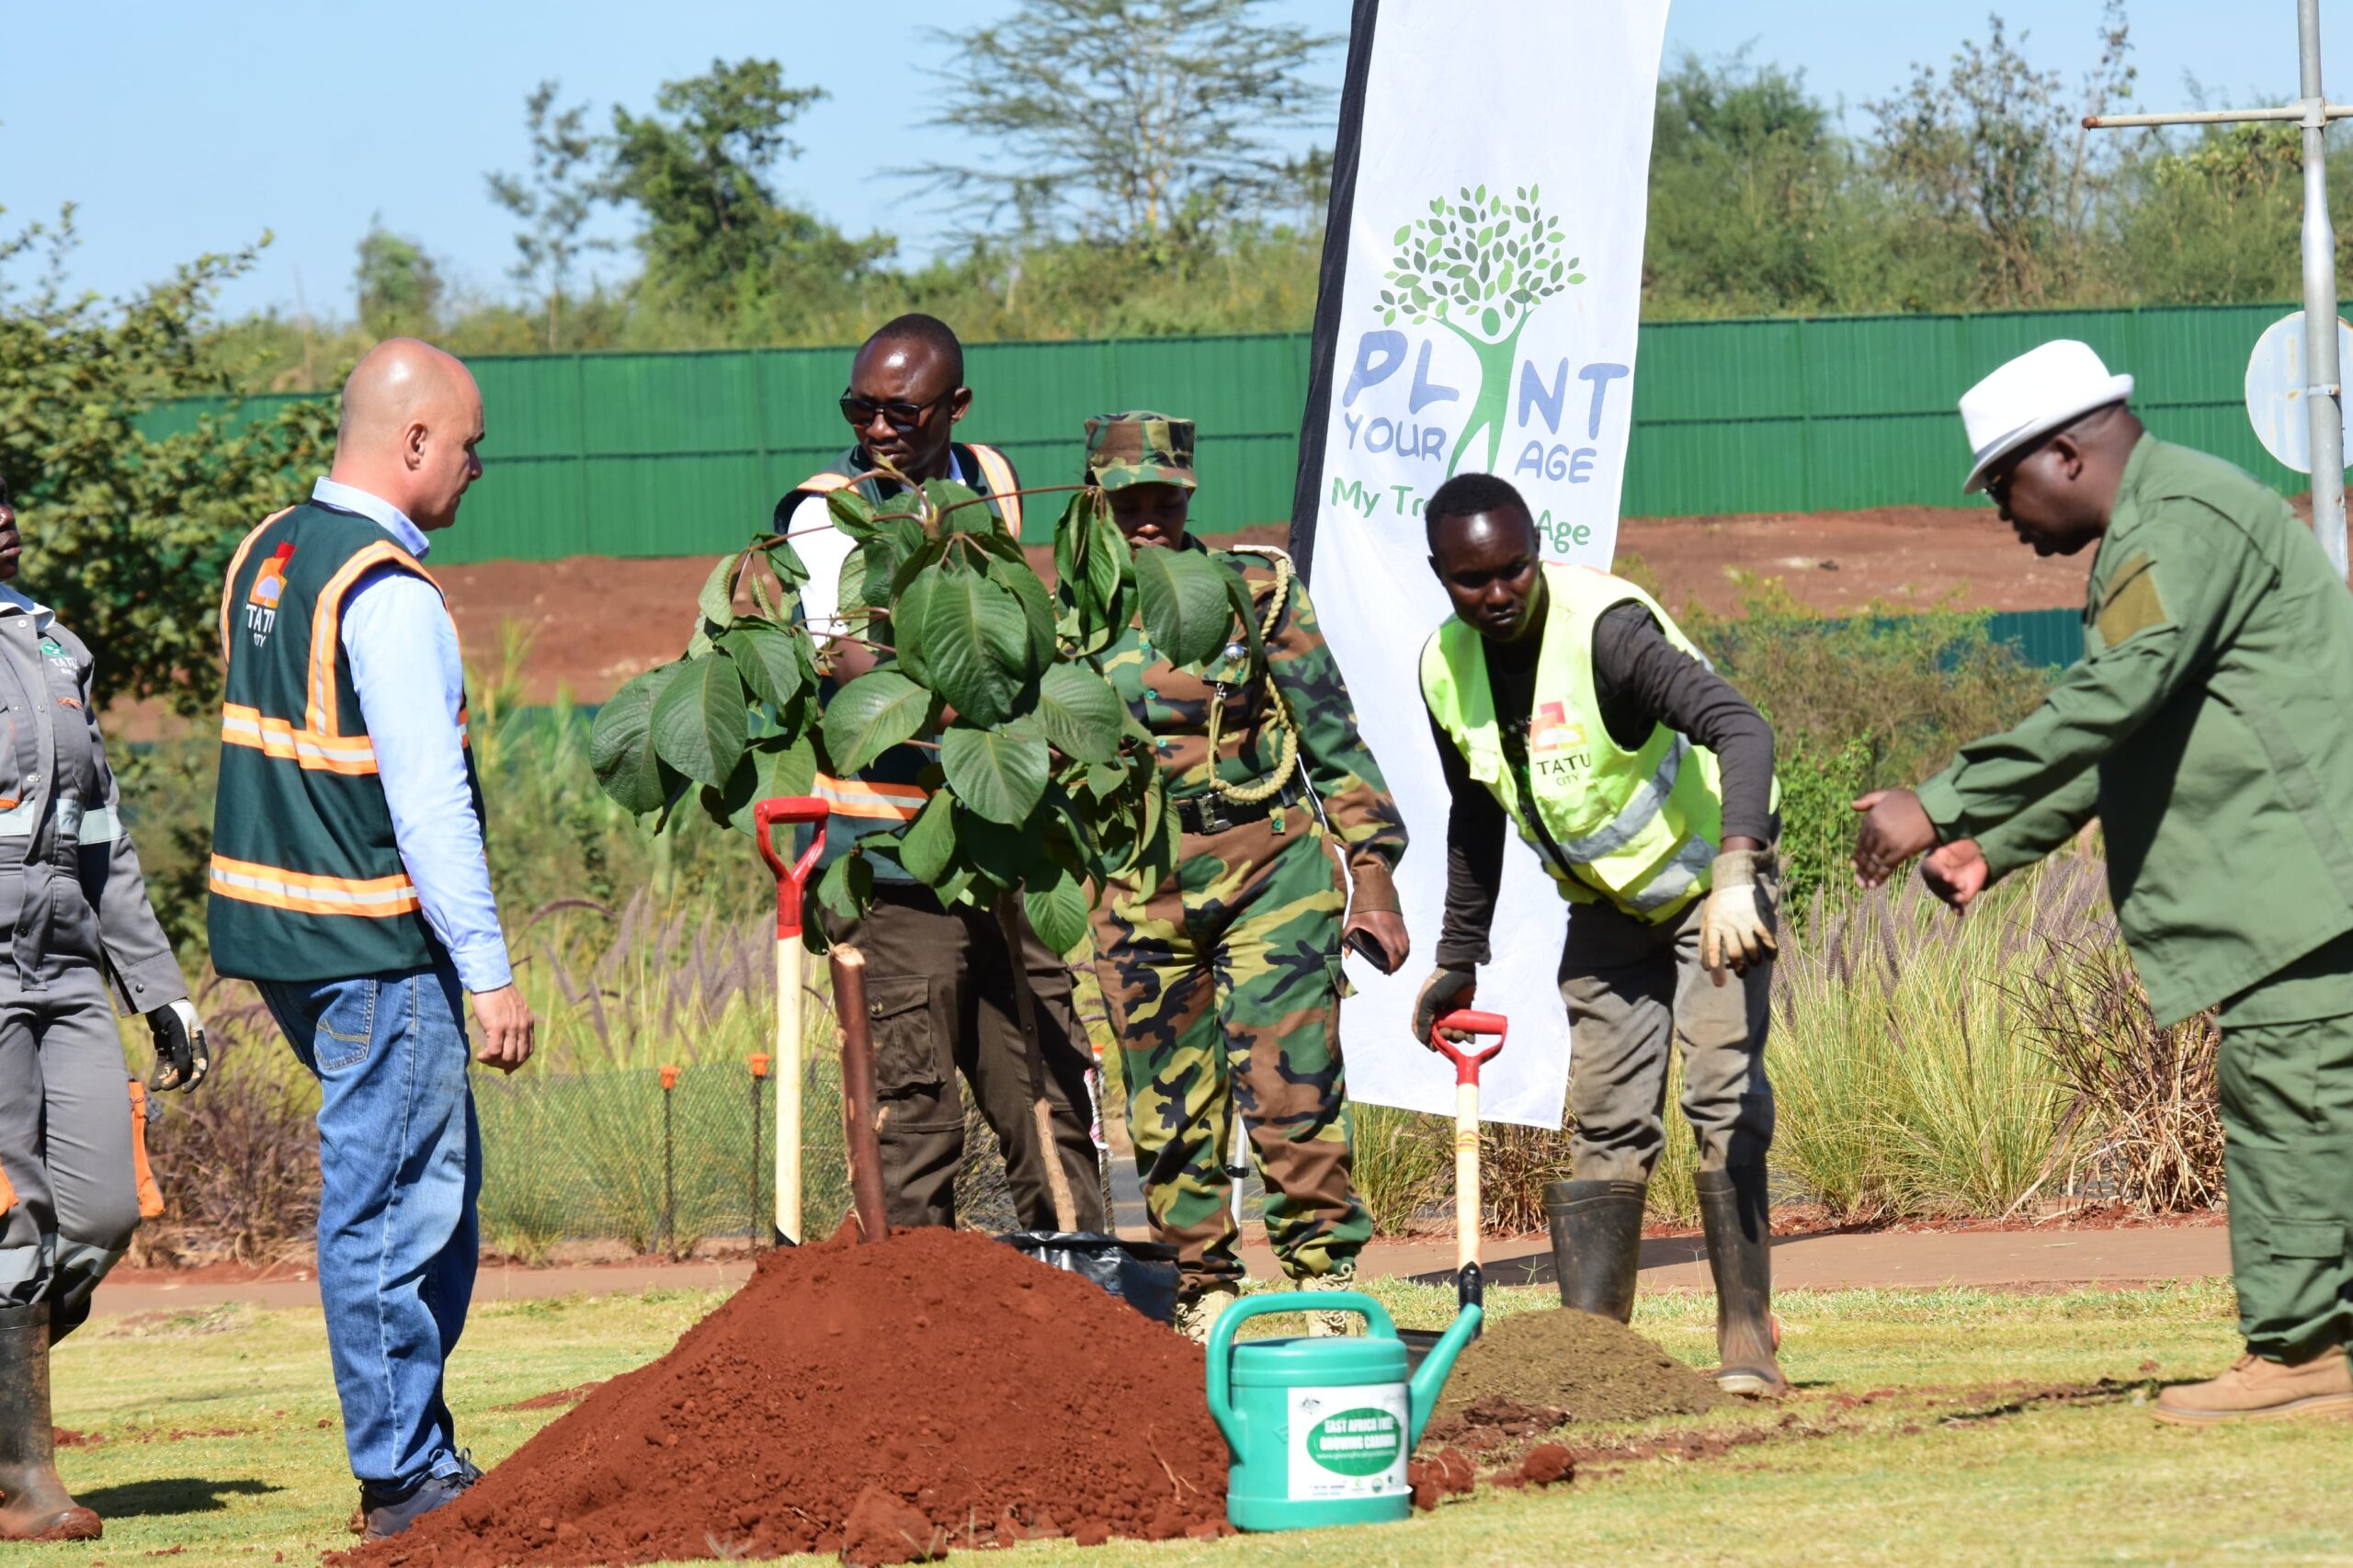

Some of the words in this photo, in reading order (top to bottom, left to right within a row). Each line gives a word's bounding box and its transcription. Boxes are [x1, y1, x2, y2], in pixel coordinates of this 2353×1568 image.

[1344, 412, 1447, 461] YOUR
[1514, 440, 1597, 484] AGE
[1331, 477, 1381, 519] My
[1390, 484, 1432, 517] Tr
[1535, 509, 1591, 554] Age
[1536, 754, 1591, 775] TATU
[1555, 773, 1579, 787] CITY
[1324, 1419, 1347, 1434] EAST
